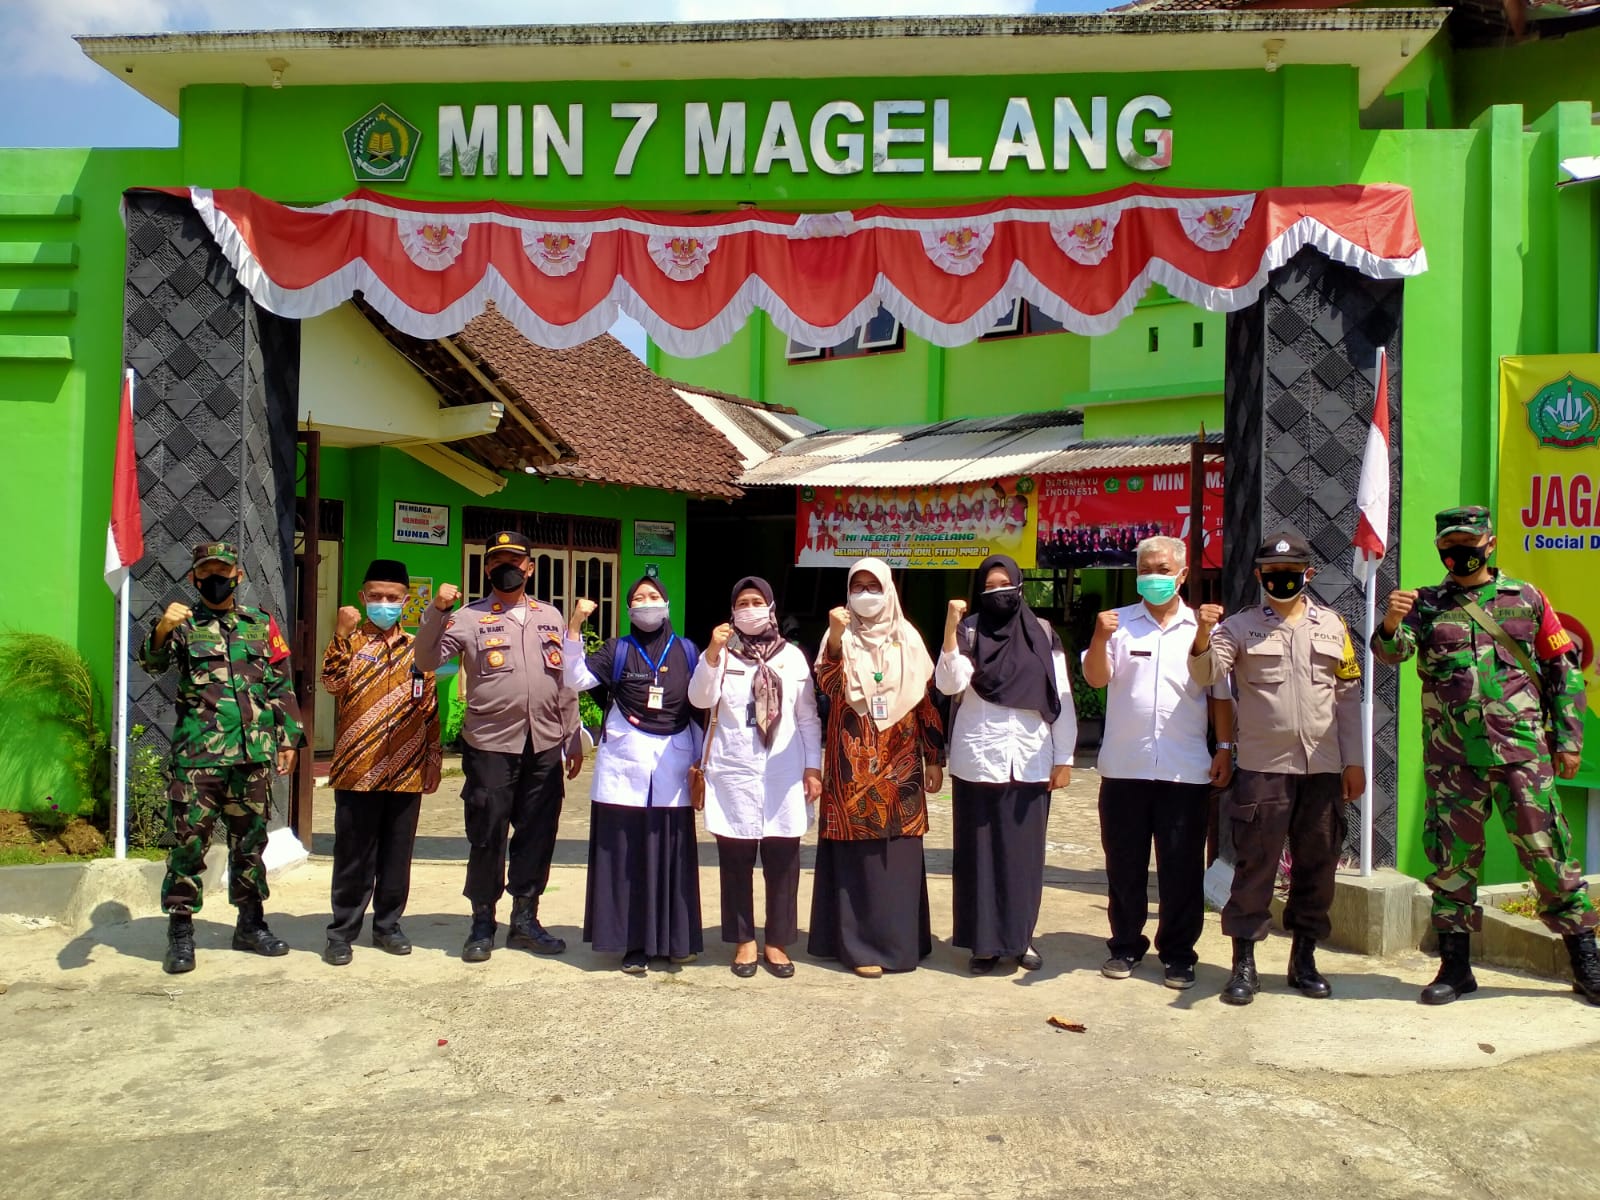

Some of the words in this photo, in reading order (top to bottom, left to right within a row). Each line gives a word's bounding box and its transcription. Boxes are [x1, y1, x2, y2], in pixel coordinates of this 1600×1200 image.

[438, 104, 583, 176] MIN
[611, 103, 658, 175] 7
[685, 95, 1173, 176] MAGELANG
[1045, 478, 1098, 487] DIRGAHAYU
[1152, 473, 1185, 491] MIN
[1045, 487, 1098, 497] INDONESIA
[397, 529, 430, 538] DUNIA
[860, 534, 901, 542] NEGERI
[904, 534, 912, 542] 7
[914, 533, 976, 542] MAGELANG
[1535, 534, 1584, 549] Social
